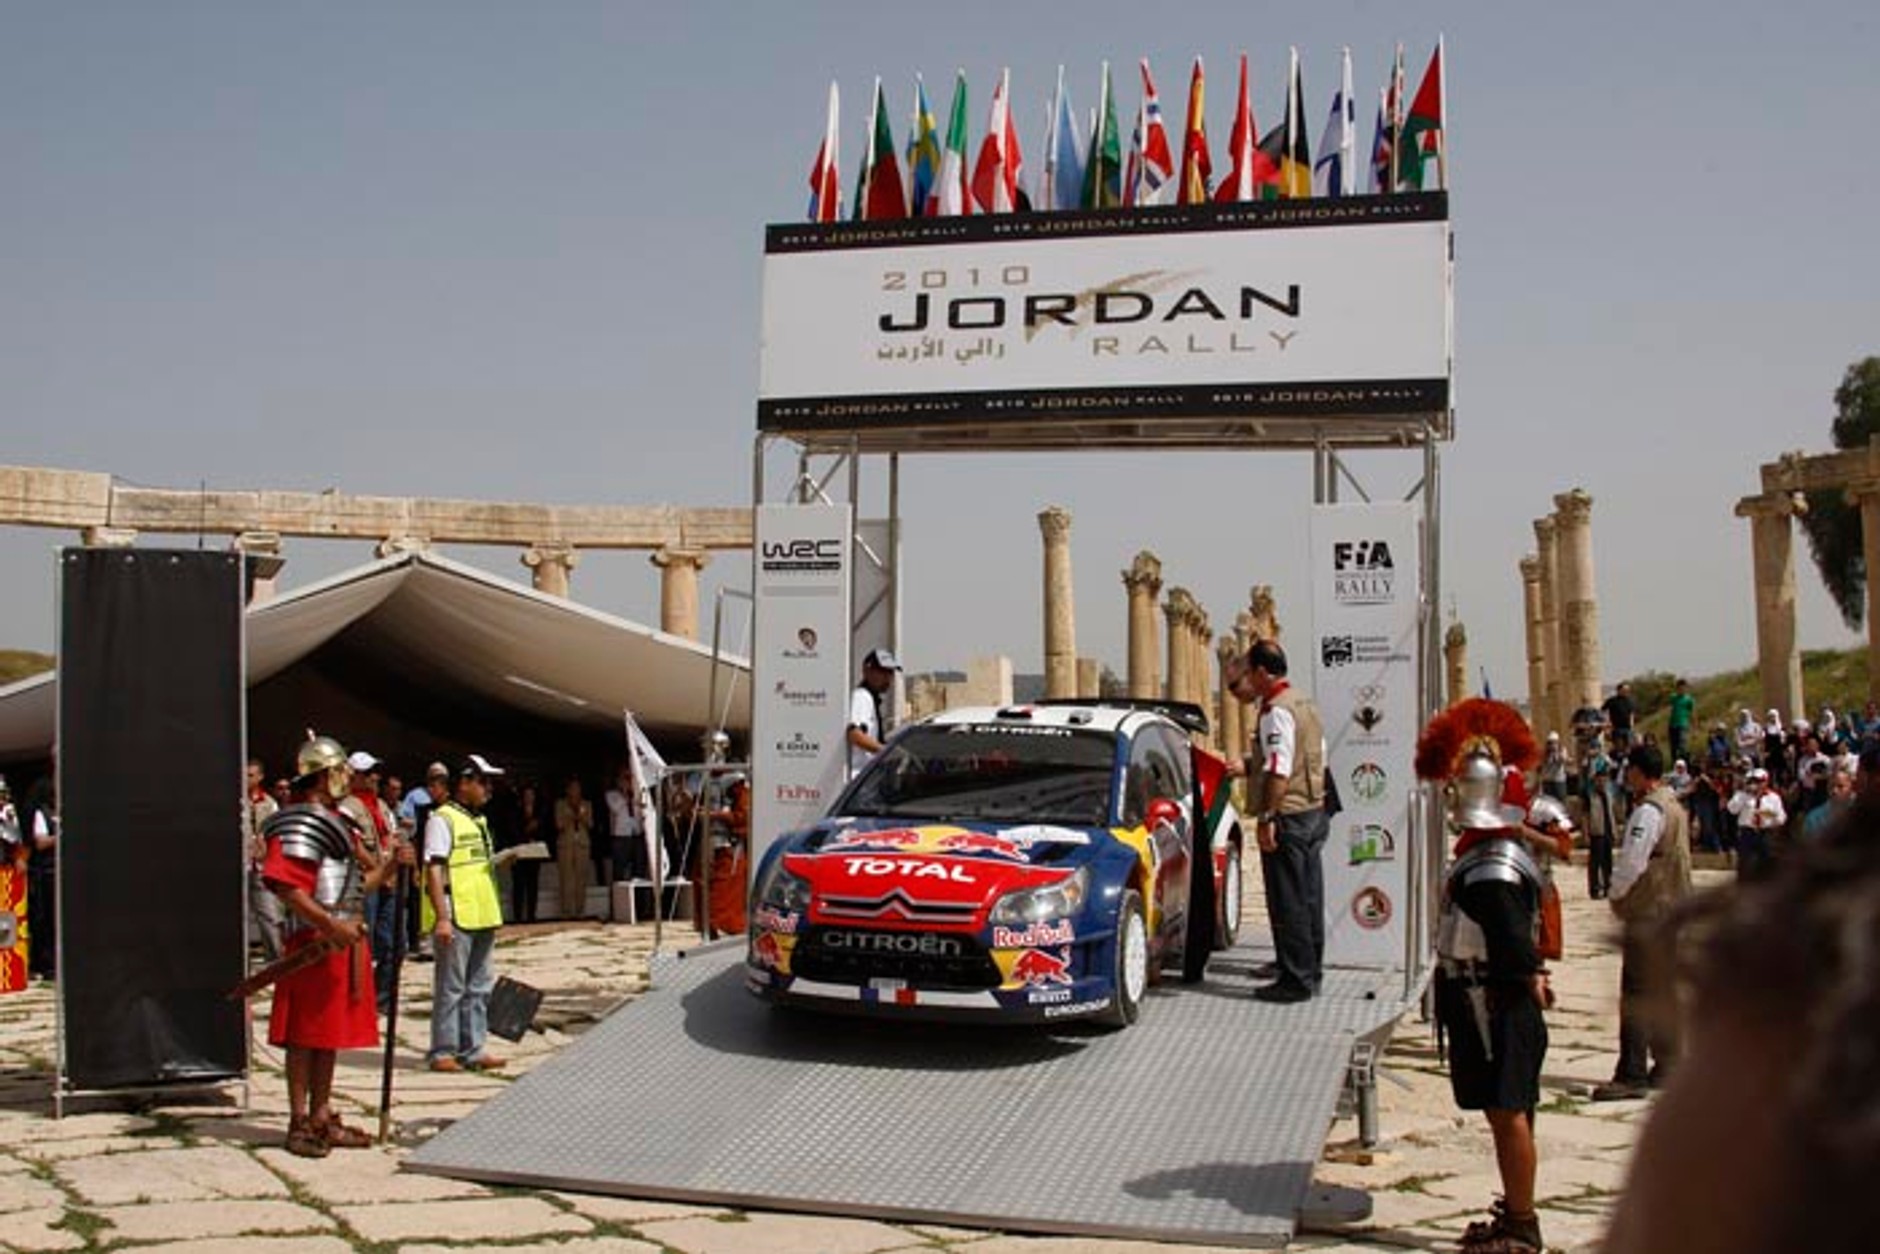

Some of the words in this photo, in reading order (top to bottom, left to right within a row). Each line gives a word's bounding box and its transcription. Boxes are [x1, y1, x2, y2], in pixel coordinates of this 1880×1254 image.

[1262, 206, 1366, 221] JORDAN
[1036, 218, 1135, 232] JORDAN
[824, 229, 919, 243] JORDAN
[882, 265, 1030, 291] 2010
[878, 284, 1301, 332] JORDAN
[1092, 331, 1298, 357] RALLY
[955, 337, 1005, 367] رالي
[1031, 396, 1130, 408] JORDAN
[1260, 391, 1364, 402] JORDAN
[816, 402, 909, 416] JORDAN
[762, 540, 840, 558] WRC
[1335, 580, 1391, 595] RALLY
[843, 857, 976, 883] TOTAL
